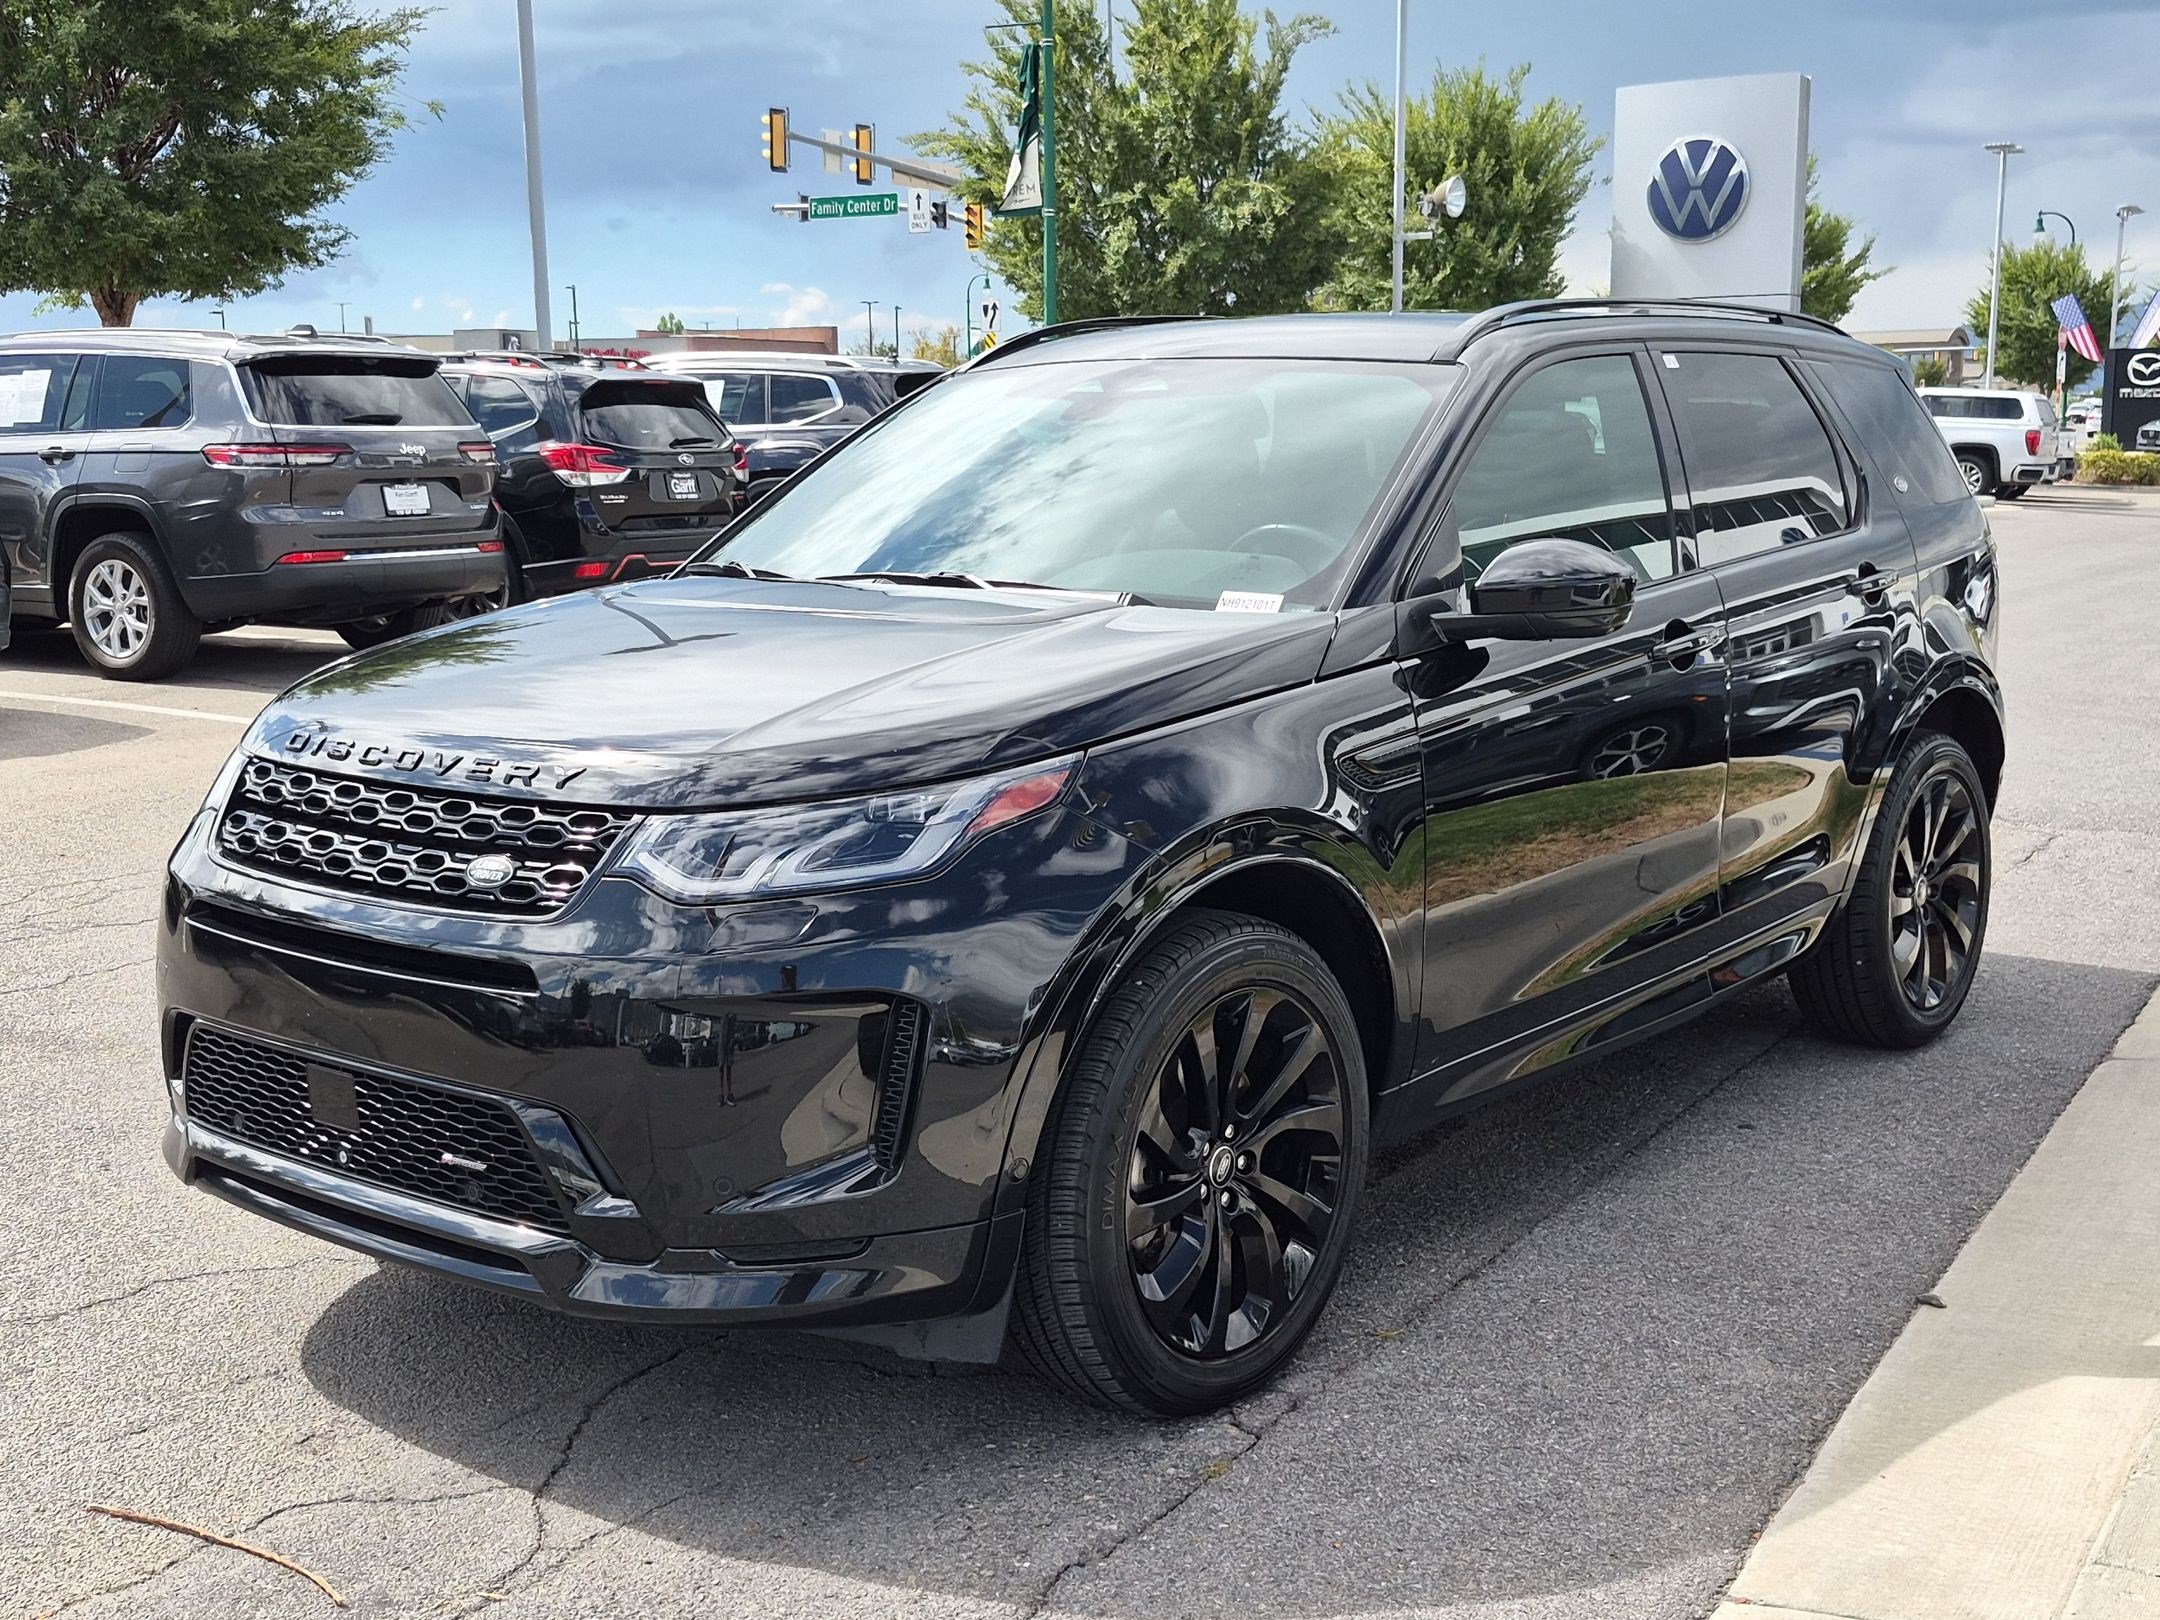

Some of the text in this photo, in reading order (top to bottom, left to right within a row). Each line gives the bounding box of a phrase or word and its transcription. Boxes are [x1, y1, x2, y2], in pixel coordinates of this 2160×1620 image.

[1012, 184, 1036, 196] REM
[1650, 138, 1748, 241] VW
[811, 198, 895, 216] Family Center Dr
[400, 443, 426, 456] Jeep
[671, 478, 696, 493] Garff
[285, 731, 588, 790] DISCOVERY
[473, 869, 504, 881] ROVER
[1102, 1134, 1124, 1230] DIMAX
